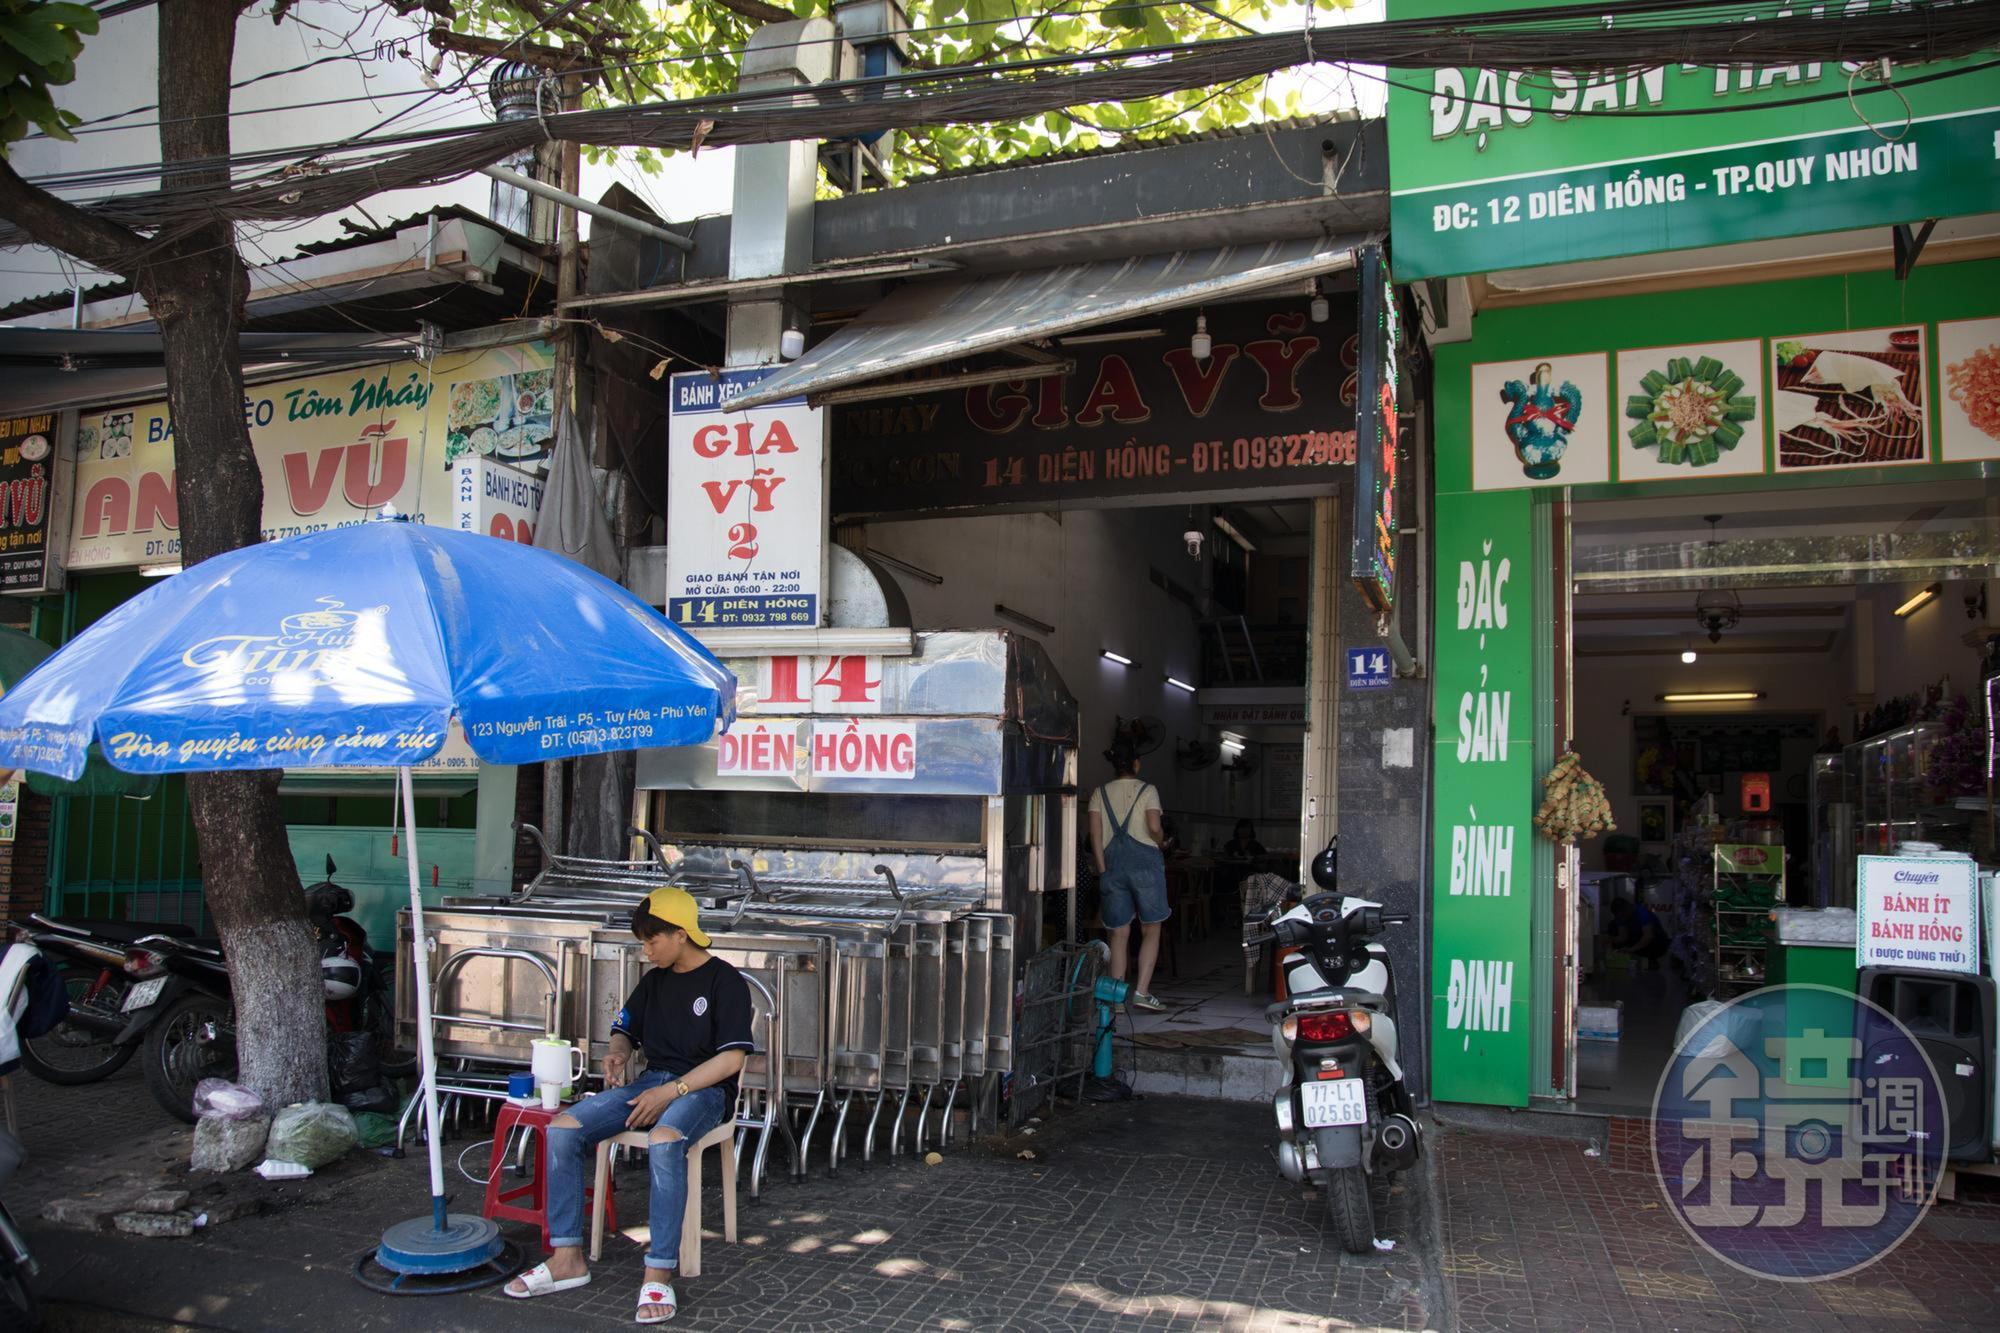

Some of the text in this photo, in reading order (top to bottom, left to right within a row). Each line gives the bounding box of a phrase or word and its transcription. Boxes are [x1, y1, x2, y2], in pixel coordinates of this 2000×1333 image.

[1433, 203, 1478, 231] ĐC:
[1487, 196, 1520, 224] 12
[1529, 183, 1596, 219] DIÊN
[1604, 169, 1686, 209] HỒNG
[1712, 156, 1815, 195] TP.QUY
[1825, 142, 1917, 181] NHƠN
[284, 387, 344, 422] Tôm
[348, 373, 434, 417] Nhảy
[681, 382, 713, 406] BÁNH
[964, 354, 1151, 433] GIA
[693, 420, 799, 459] GIA
[282, 419, 408, 516] VŨ
[977, 456, 1026, 487] 14
[1038, 445, 1095, 483] DIÊN
[1105, 436, 1170, 480] HỒNG
[486, 468, 544, 512] BÁNH XÈO TÔ
[702, 467, 786, 514] VỸ
[728, 523, 759, 560] 2
[686, 570, 800, 583] GIAO BÁNH TẬN NƠI
[734, 585, 760, 594] 06:00
[772, 584, 800, 593] 22:00
[1458, 539, 1511, 650] ĐẶC
[677, 597, 808, 623] 14 DIÊN HỒNG
[722, 612, 809, 623] ĐT: 0932 798 669
[757, 655, 882, 703] 14
[1351, 653, 1388, 675] 14
[472, 723, 493, 737] 123
[496, 716, 542, 734] Nguyễn
[545, 715, 567, 729] Trãi
[578, 714, 593, 726] P5
[605, 711, 625, 723] Tuy
[661, 706, 684, 719] Phú
[687, 704, 708, 717] Yên
[1457, 664, 1511, 763] SẢN
[109, 732, 170, 759] Hòa
[178, 732, 257, 763] quyện
[265, 728, 326, 758] cùng
[333, 726, 390, 749] cảm
[396, 726, 437, 749] xúc
[541, 726, 653, 749] ĐT: (057)3.823799
[719, 716, 914, 773] DIÊN HỒNG
[1450, 804, 1514, 896] BÌNH
[1894, 871, 1940, 884] Chuyên
[1883, 892, 1951, 914] BÁNH ÍT
[1871, 917, 1963, 942] BÁNH HỒNG
[1907, 948, 1936, 961] DÙNG
[1447, 959, 1514, 1052] ĐỊNH
[1308, 1103, 1361, 1123] 025.66
